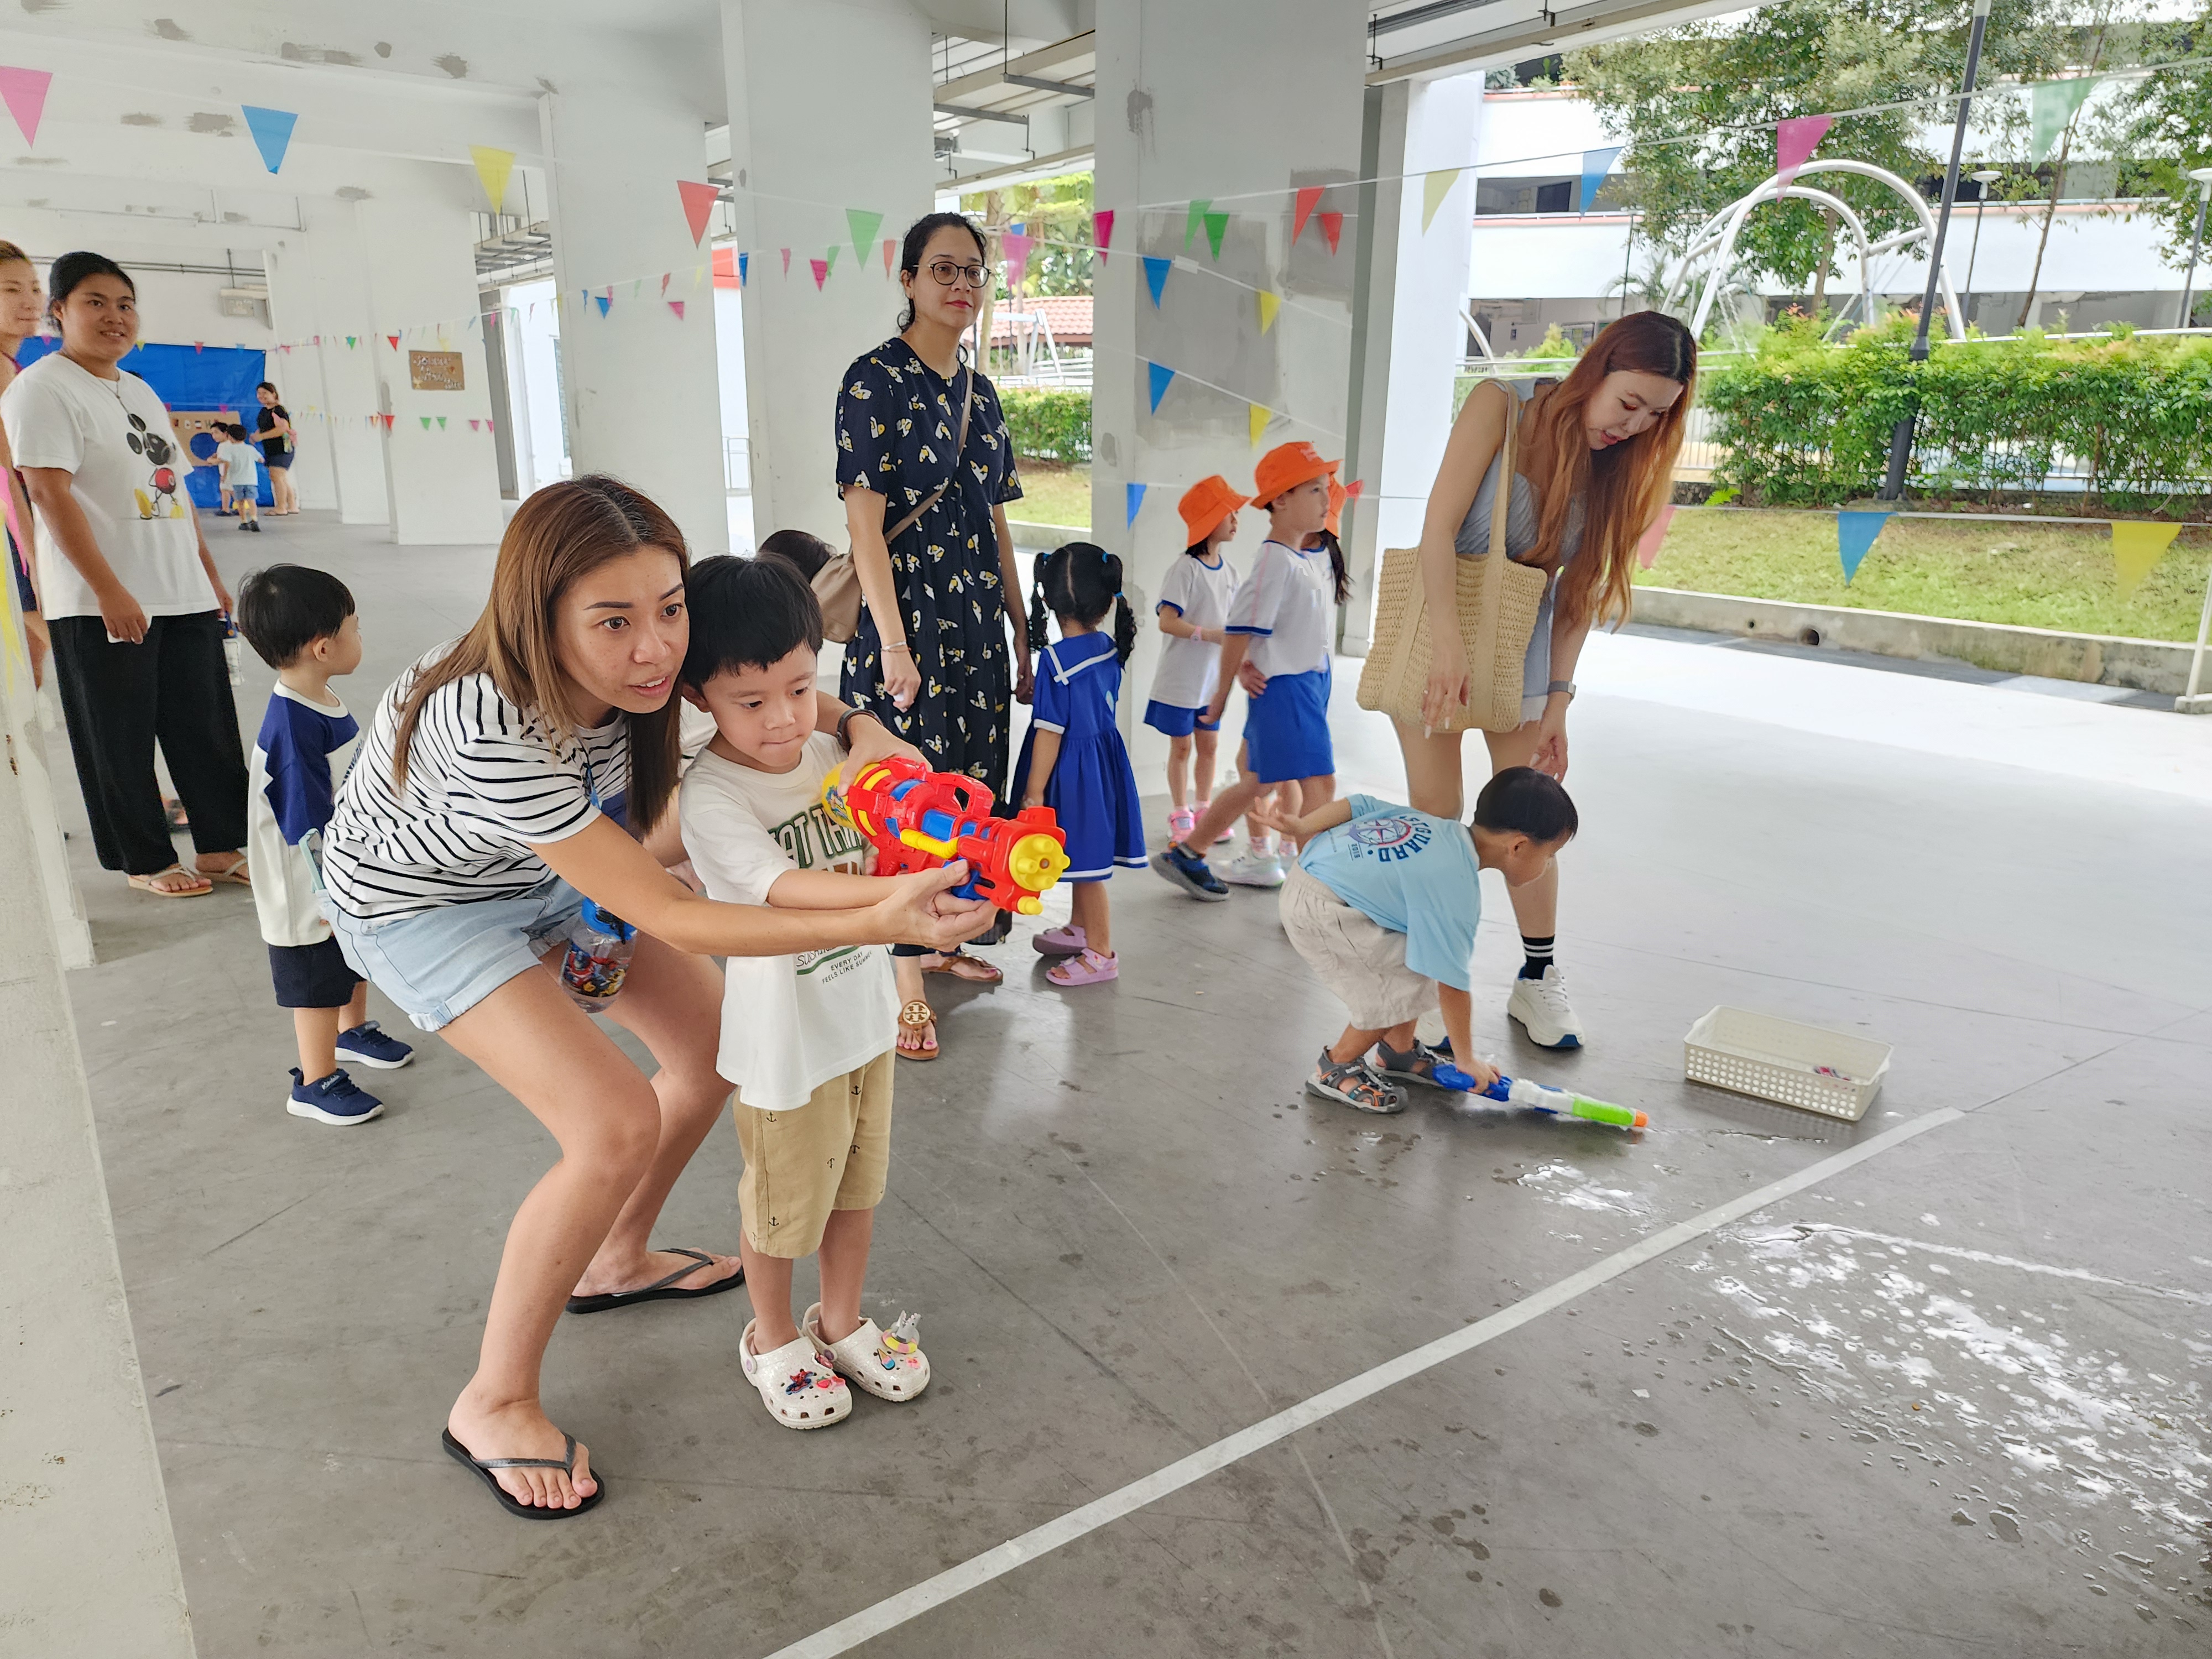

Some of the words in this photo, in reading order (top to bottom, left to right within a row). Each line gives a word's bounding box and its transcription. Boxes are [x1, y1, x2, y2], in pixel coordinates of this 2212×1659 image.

[831, 958, 852, 971] EVERY
[853, 951, 863, 961] DAY
[822, 972, 838, 984] FEELS
[839, 964, 854, 974] LIKE
